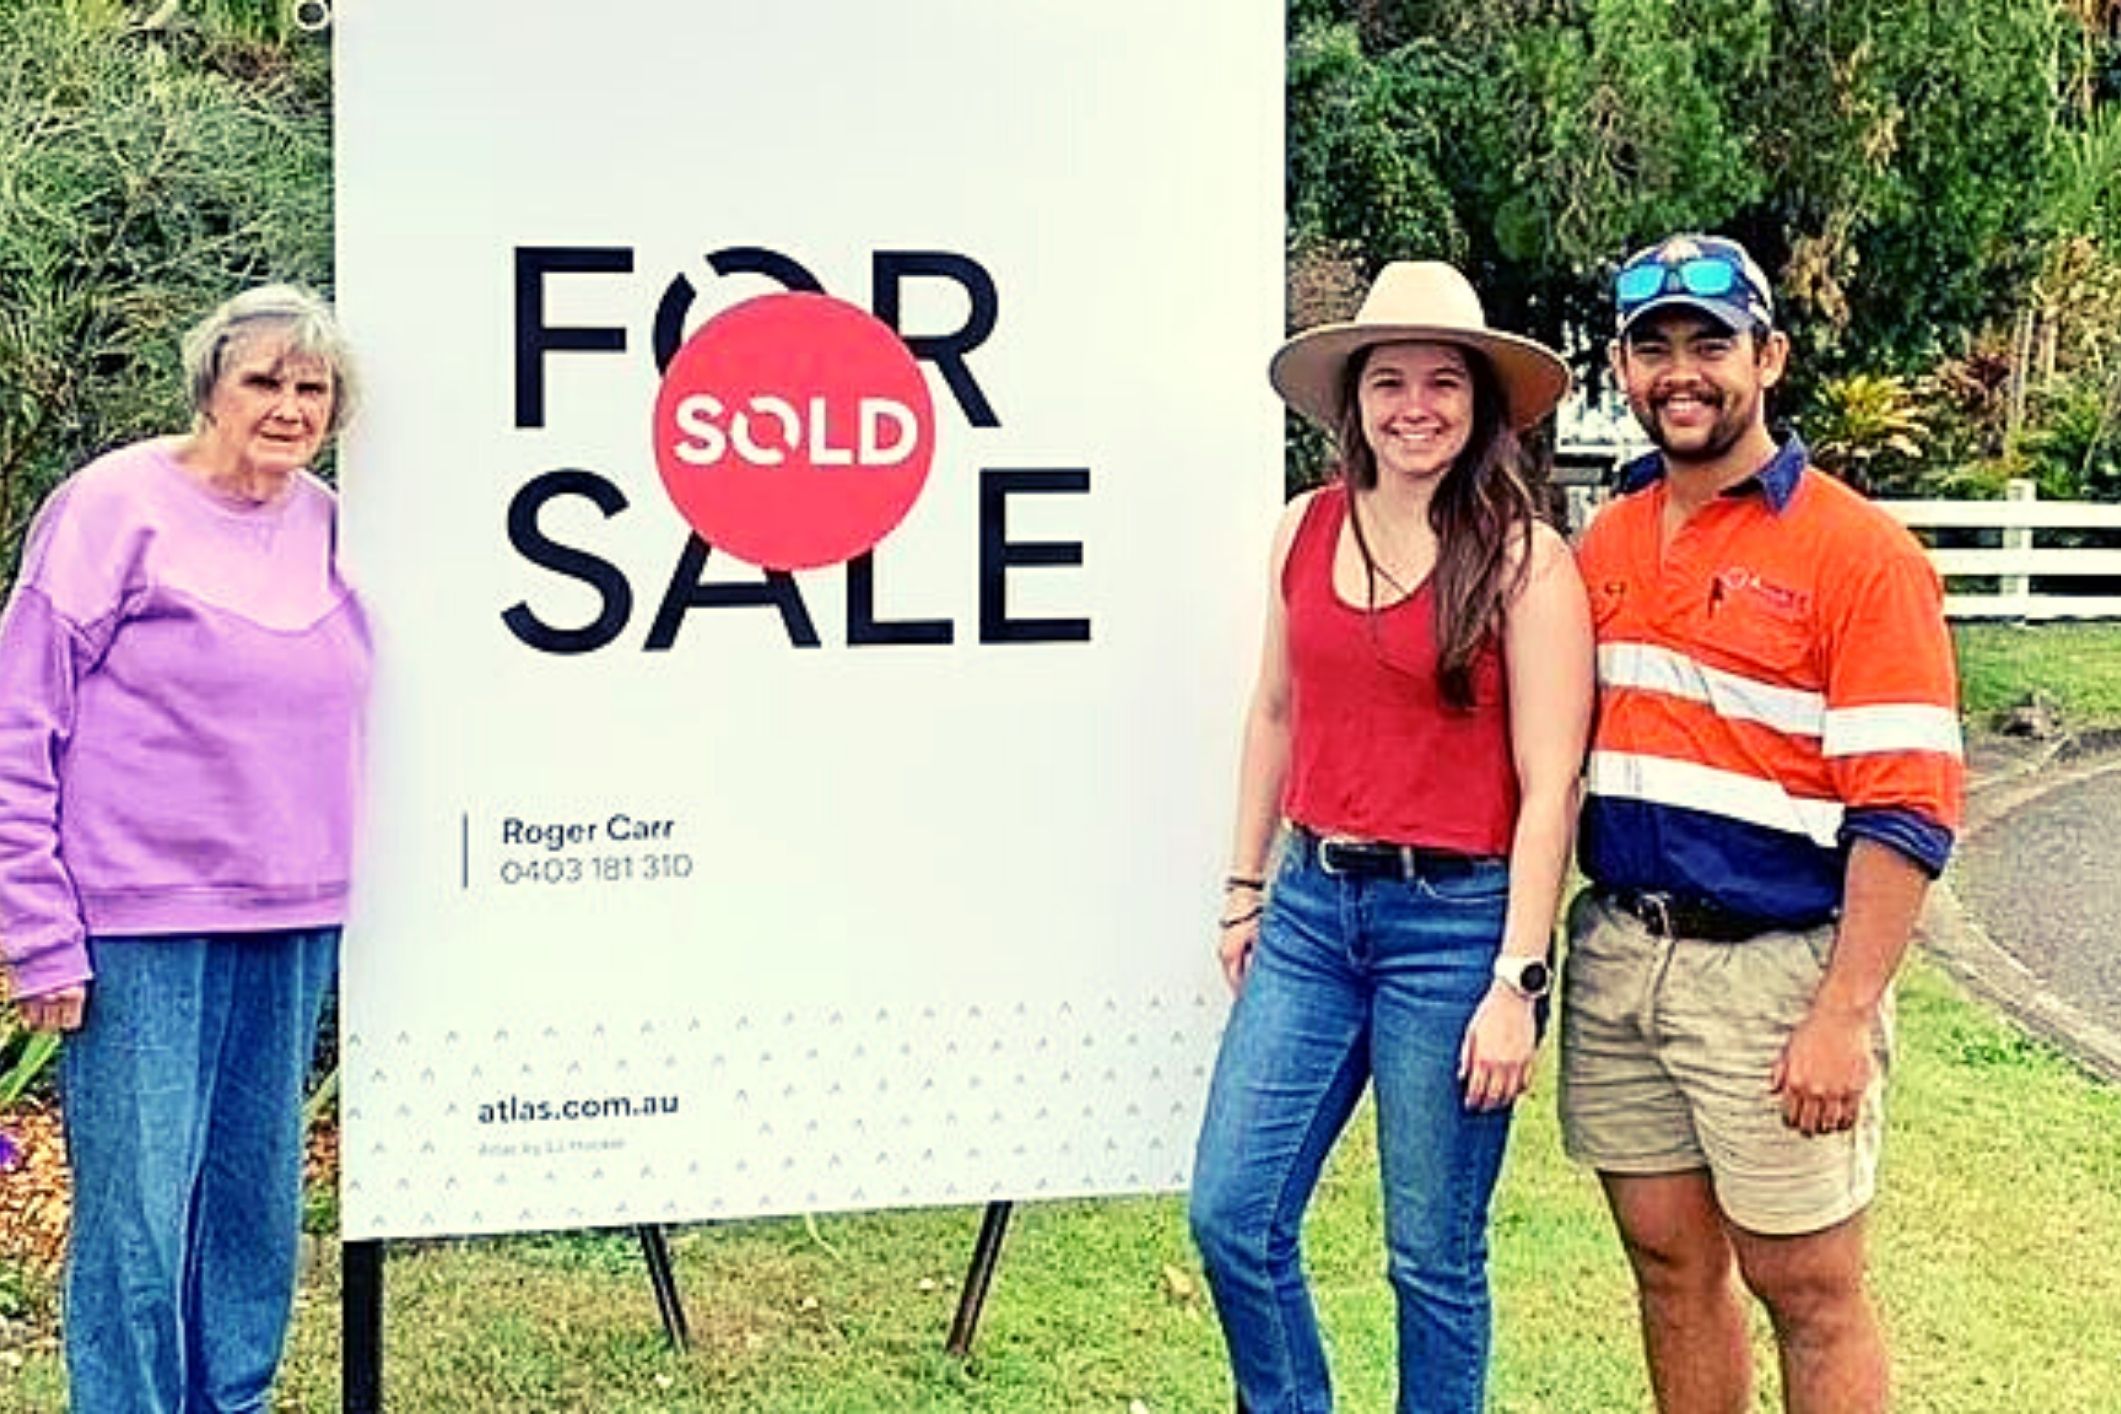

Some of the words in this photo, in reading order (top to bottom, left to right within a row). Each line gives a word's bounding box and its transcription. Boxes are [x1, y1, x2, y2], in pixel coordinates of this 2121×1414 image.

[672, 393, 919, 466] SOLD
[500, 467, 1091, 655] SALE
[502, 816, 597, 851] Roger
[606, 813, 675, 841] Carr
[500, 856, 583, 884] 0403
[592, 854, 633, 881] 181
[643, 852, 693, 880] 310
[478, 1094, 679, 1124] atlas.com.au
